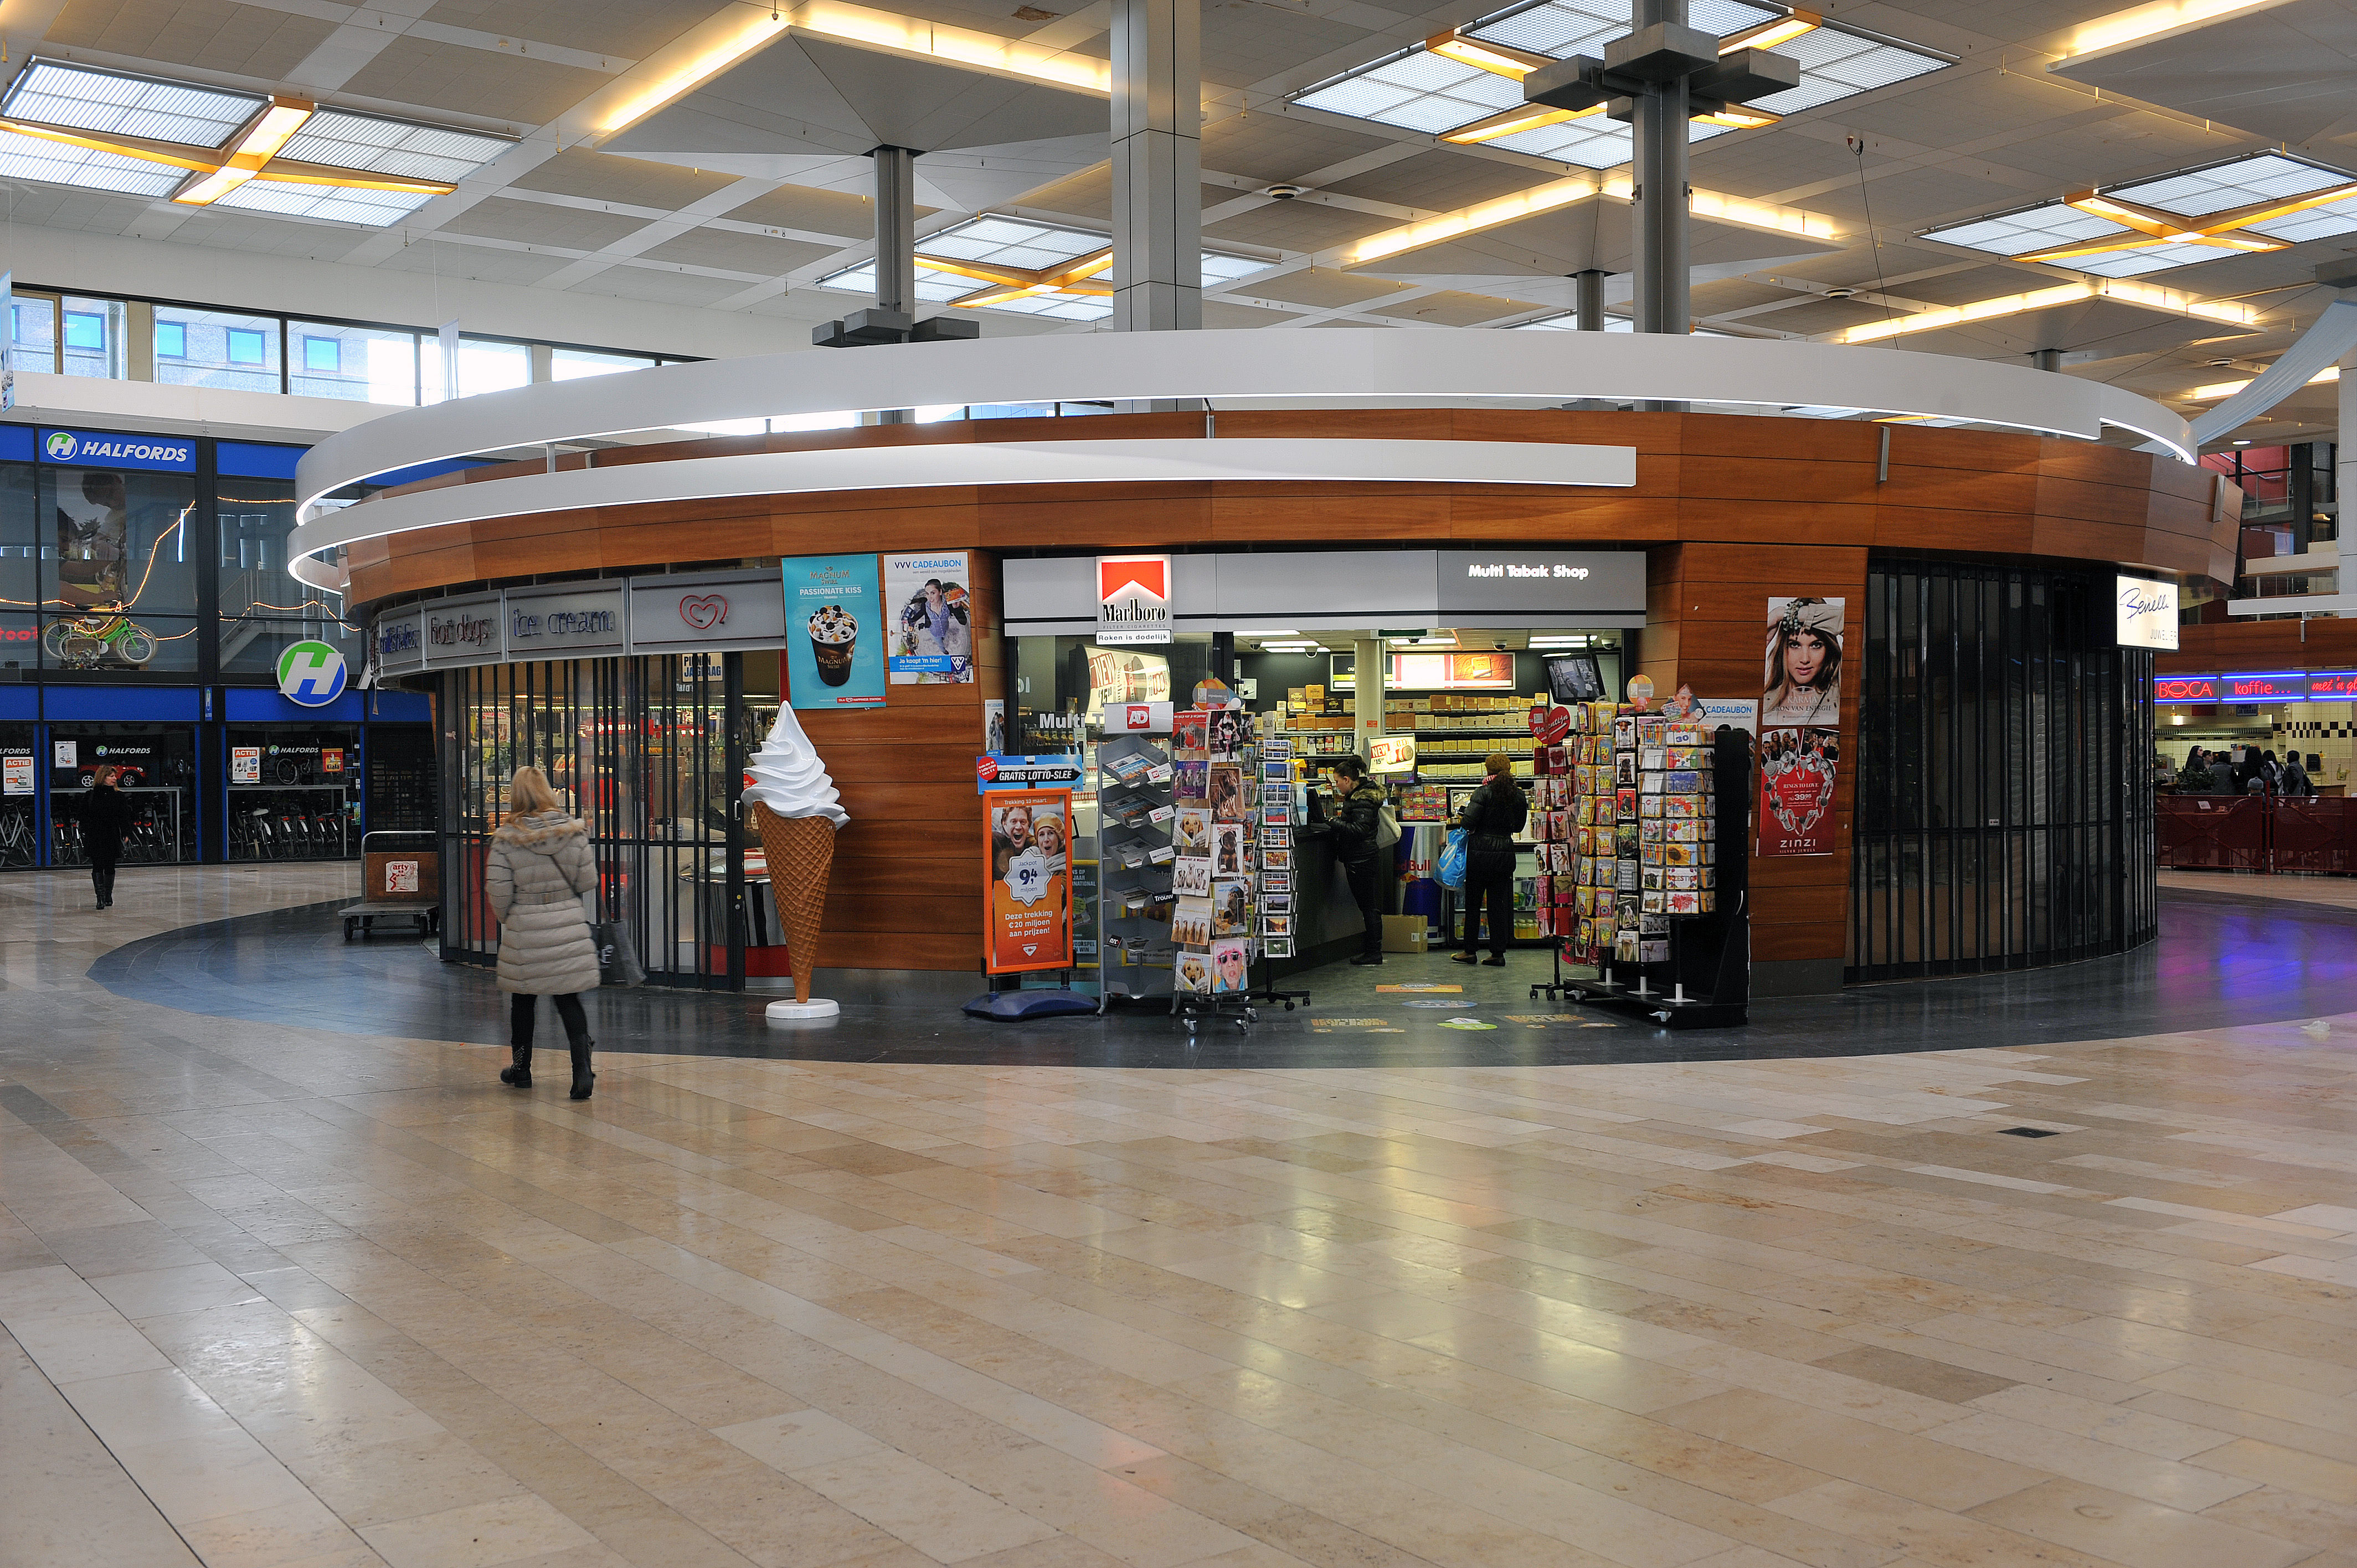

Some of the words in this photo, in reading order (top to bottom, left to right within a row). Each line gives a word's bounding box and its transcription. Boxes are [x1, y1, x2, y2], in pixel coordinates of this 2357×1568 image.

[81, 441, 188, 462] HALFORDS
[894, 561, 911, 569] VVV
[912, 560, 961, 569] CADEAUBON
[810, 569, 850, 580] MAGNUM
[1468, 564, 1504, 577] Multi
[1506, 564, 1550, 577] Tabak
[1553, 564, 1589, 580] Shop
[800, 587, 844, 596] PASSIONATE
[1103, 598, 1167, 622] Marlboro
[513, 608, 541, 637] ice
[548, 611, 616, 634] cream
[818, 656, 850, 665] MAGNUM
[1093, 653, 1114, 688] NEW
[2159, 680, 2214, 698] BOCA
[1787, 695, 1818, 704] KARMA
[1039, 713, 1085, 729] Multi
[1128, 710, 1149, 725] AD
[1371, 744, 1388, 757] NEW
[999, 771, 1026, 781] GRATIS
[1027, 770, 1072, 780] LOTTO-SLEE
[1408, 859, 1431, 871] Bull
[1155, 894, 1174, 902] Trouw
[1024, 910, 1053, 919] trekking
[1024, 927, 1051, 937] prijzen!
